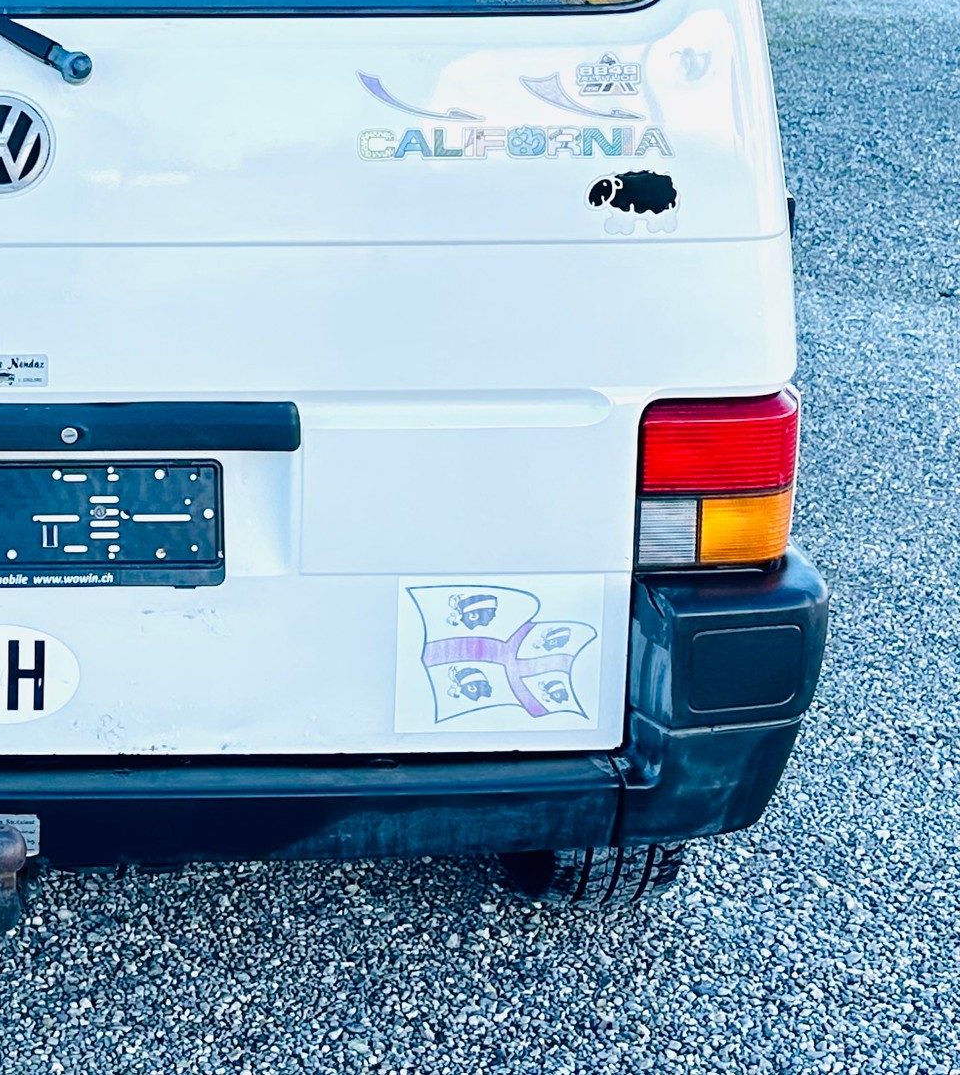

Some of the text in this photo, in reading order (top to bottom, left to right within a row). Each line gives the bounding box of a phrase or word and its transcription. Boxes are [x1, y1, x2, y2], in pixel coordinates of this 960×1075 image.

[579, 65, 637, 75] 8848
[358, 126, 675, 160] CALIFORNIA
[8, 357, 45, 370] Nendaz
[33, 572, 114, 584] www.wowin.ch
